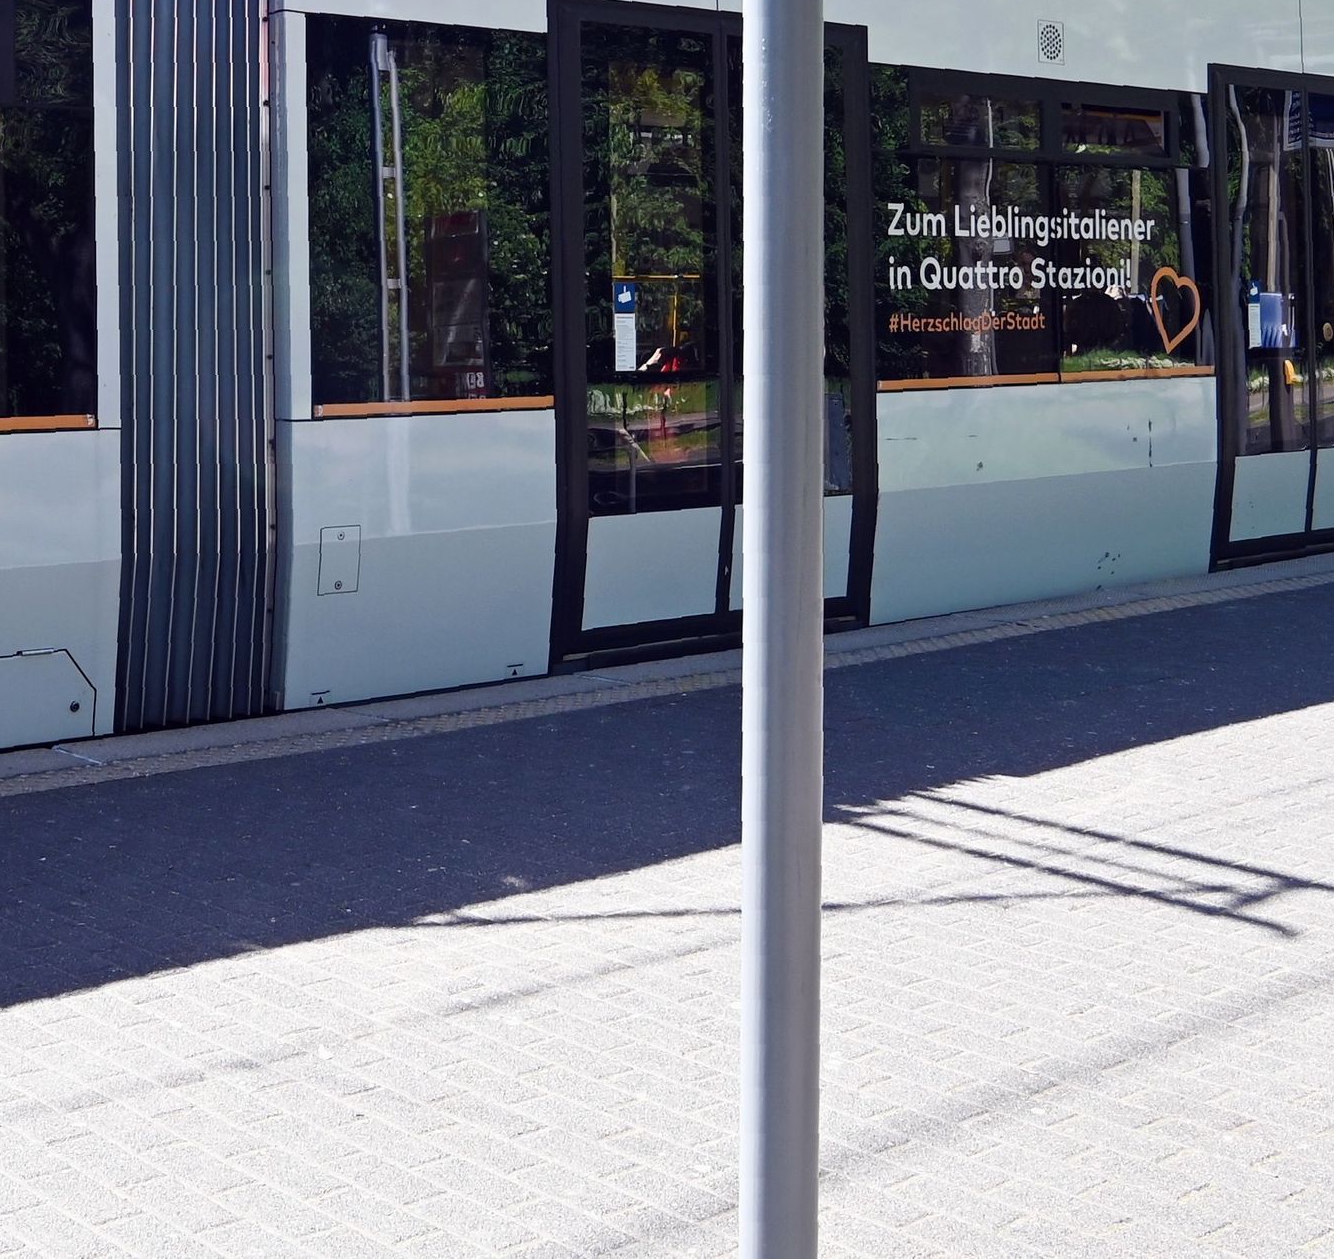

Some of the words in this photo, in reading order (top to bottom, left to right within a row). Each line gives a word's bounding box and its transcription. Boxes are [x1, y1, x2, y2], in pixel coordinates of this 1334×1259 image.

[887, 203, 946, 236] Zum
[954, 204, 1156, 247] Lieblingsitaliener
[888, 257, 912, 291] in
[919, 256, 1023, 290] Quattro
[1031, 257, 1132, 289] Stazioni!
[888, 310, 1046, 333] #HerzschlagDerStadt
